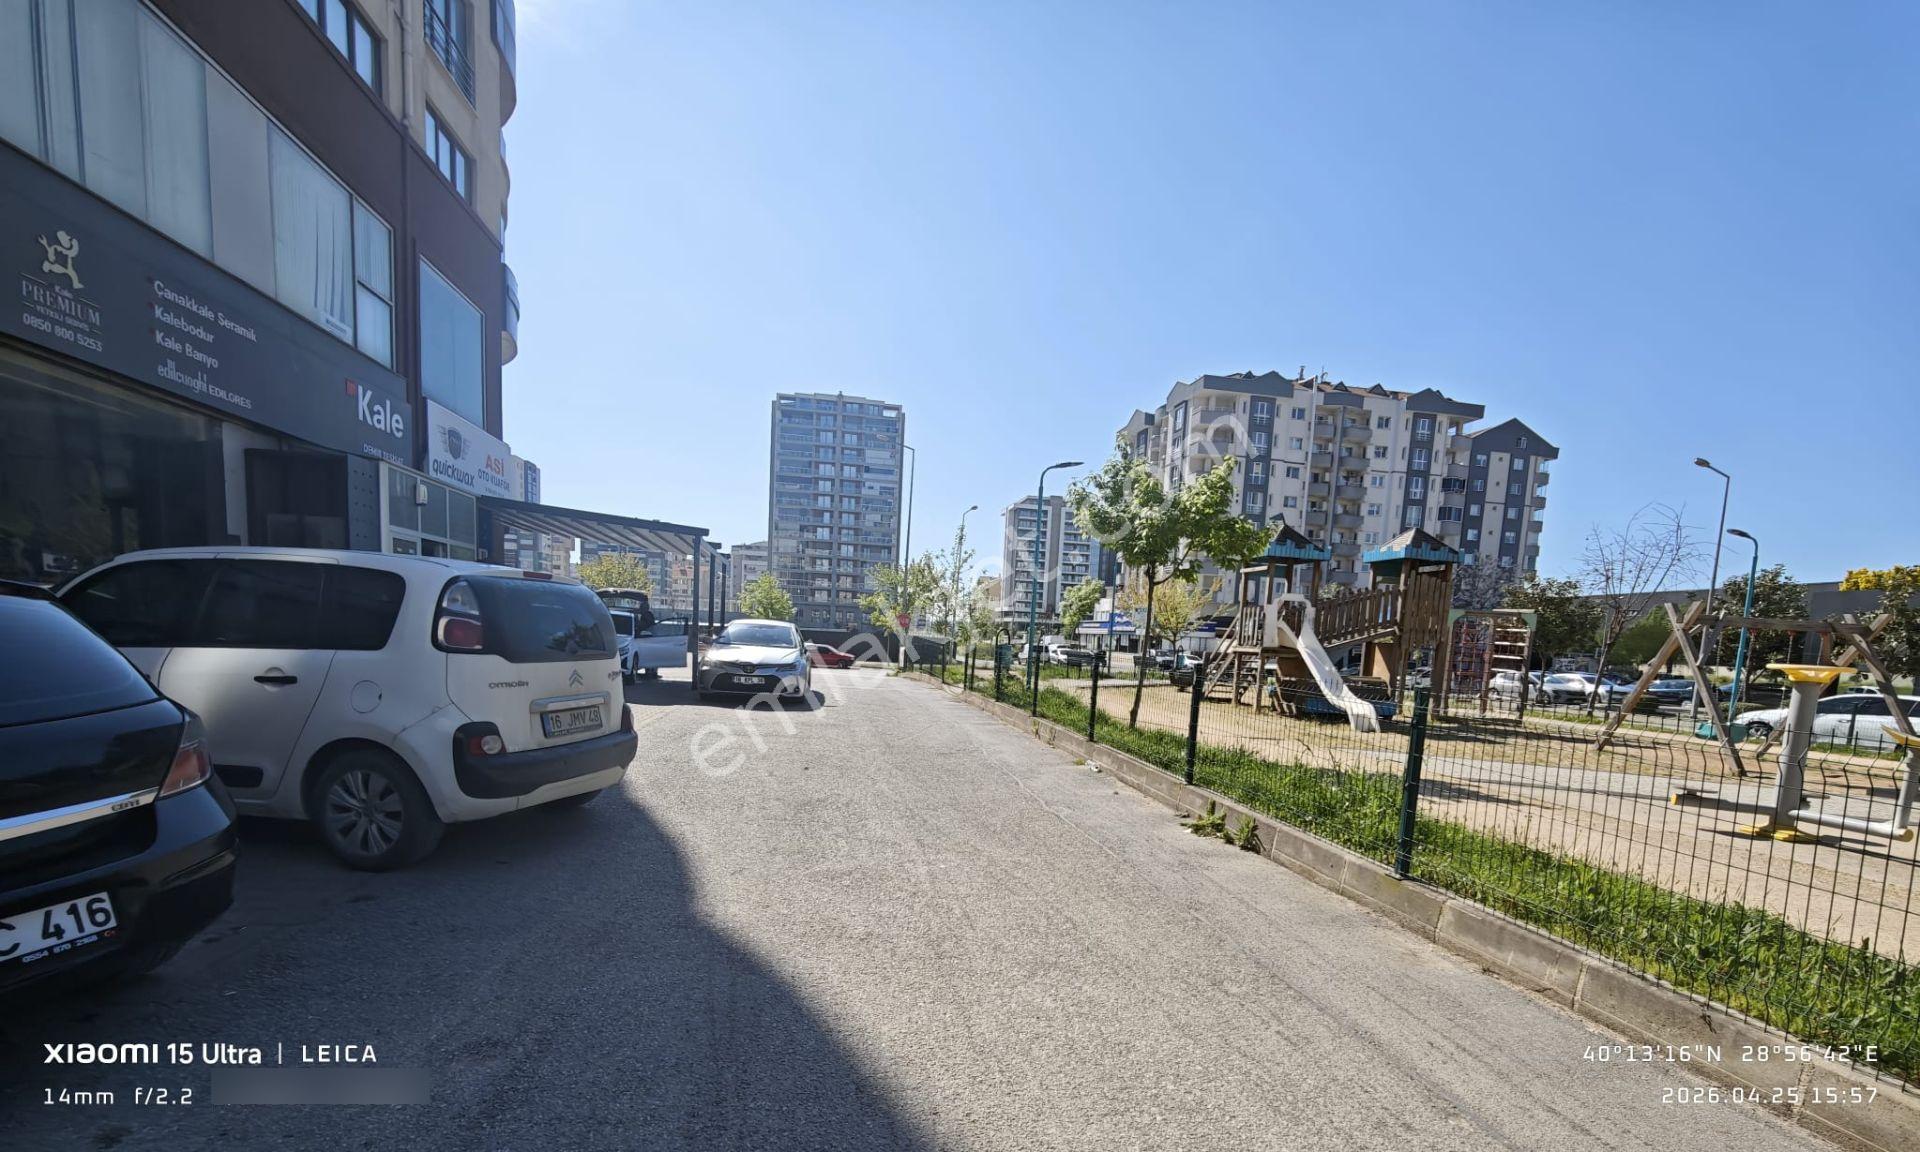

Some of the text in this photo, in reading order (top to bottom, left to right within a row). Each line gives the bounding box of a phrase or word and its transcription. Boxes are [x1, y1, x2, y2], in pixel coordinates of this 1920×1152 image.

[22, 280, 100, 326] PREMIUM
[154, 280, 257, 342] Çanakkale Seramik
[23, 313, 103, 352] 0850 800 5253
[155, 304, 214, 343] Kalebodur
[155, 330, 218, 368] Kale Banyo
[357, 385, 404, 439] Kale
[432, 459, 476, 488] quickwax
[478, 468, 490, 482] OTO
[550, 714, 562, 730] 16
[568, 711, 586, 727] JMV
[41, 897, 112, 941] 416
